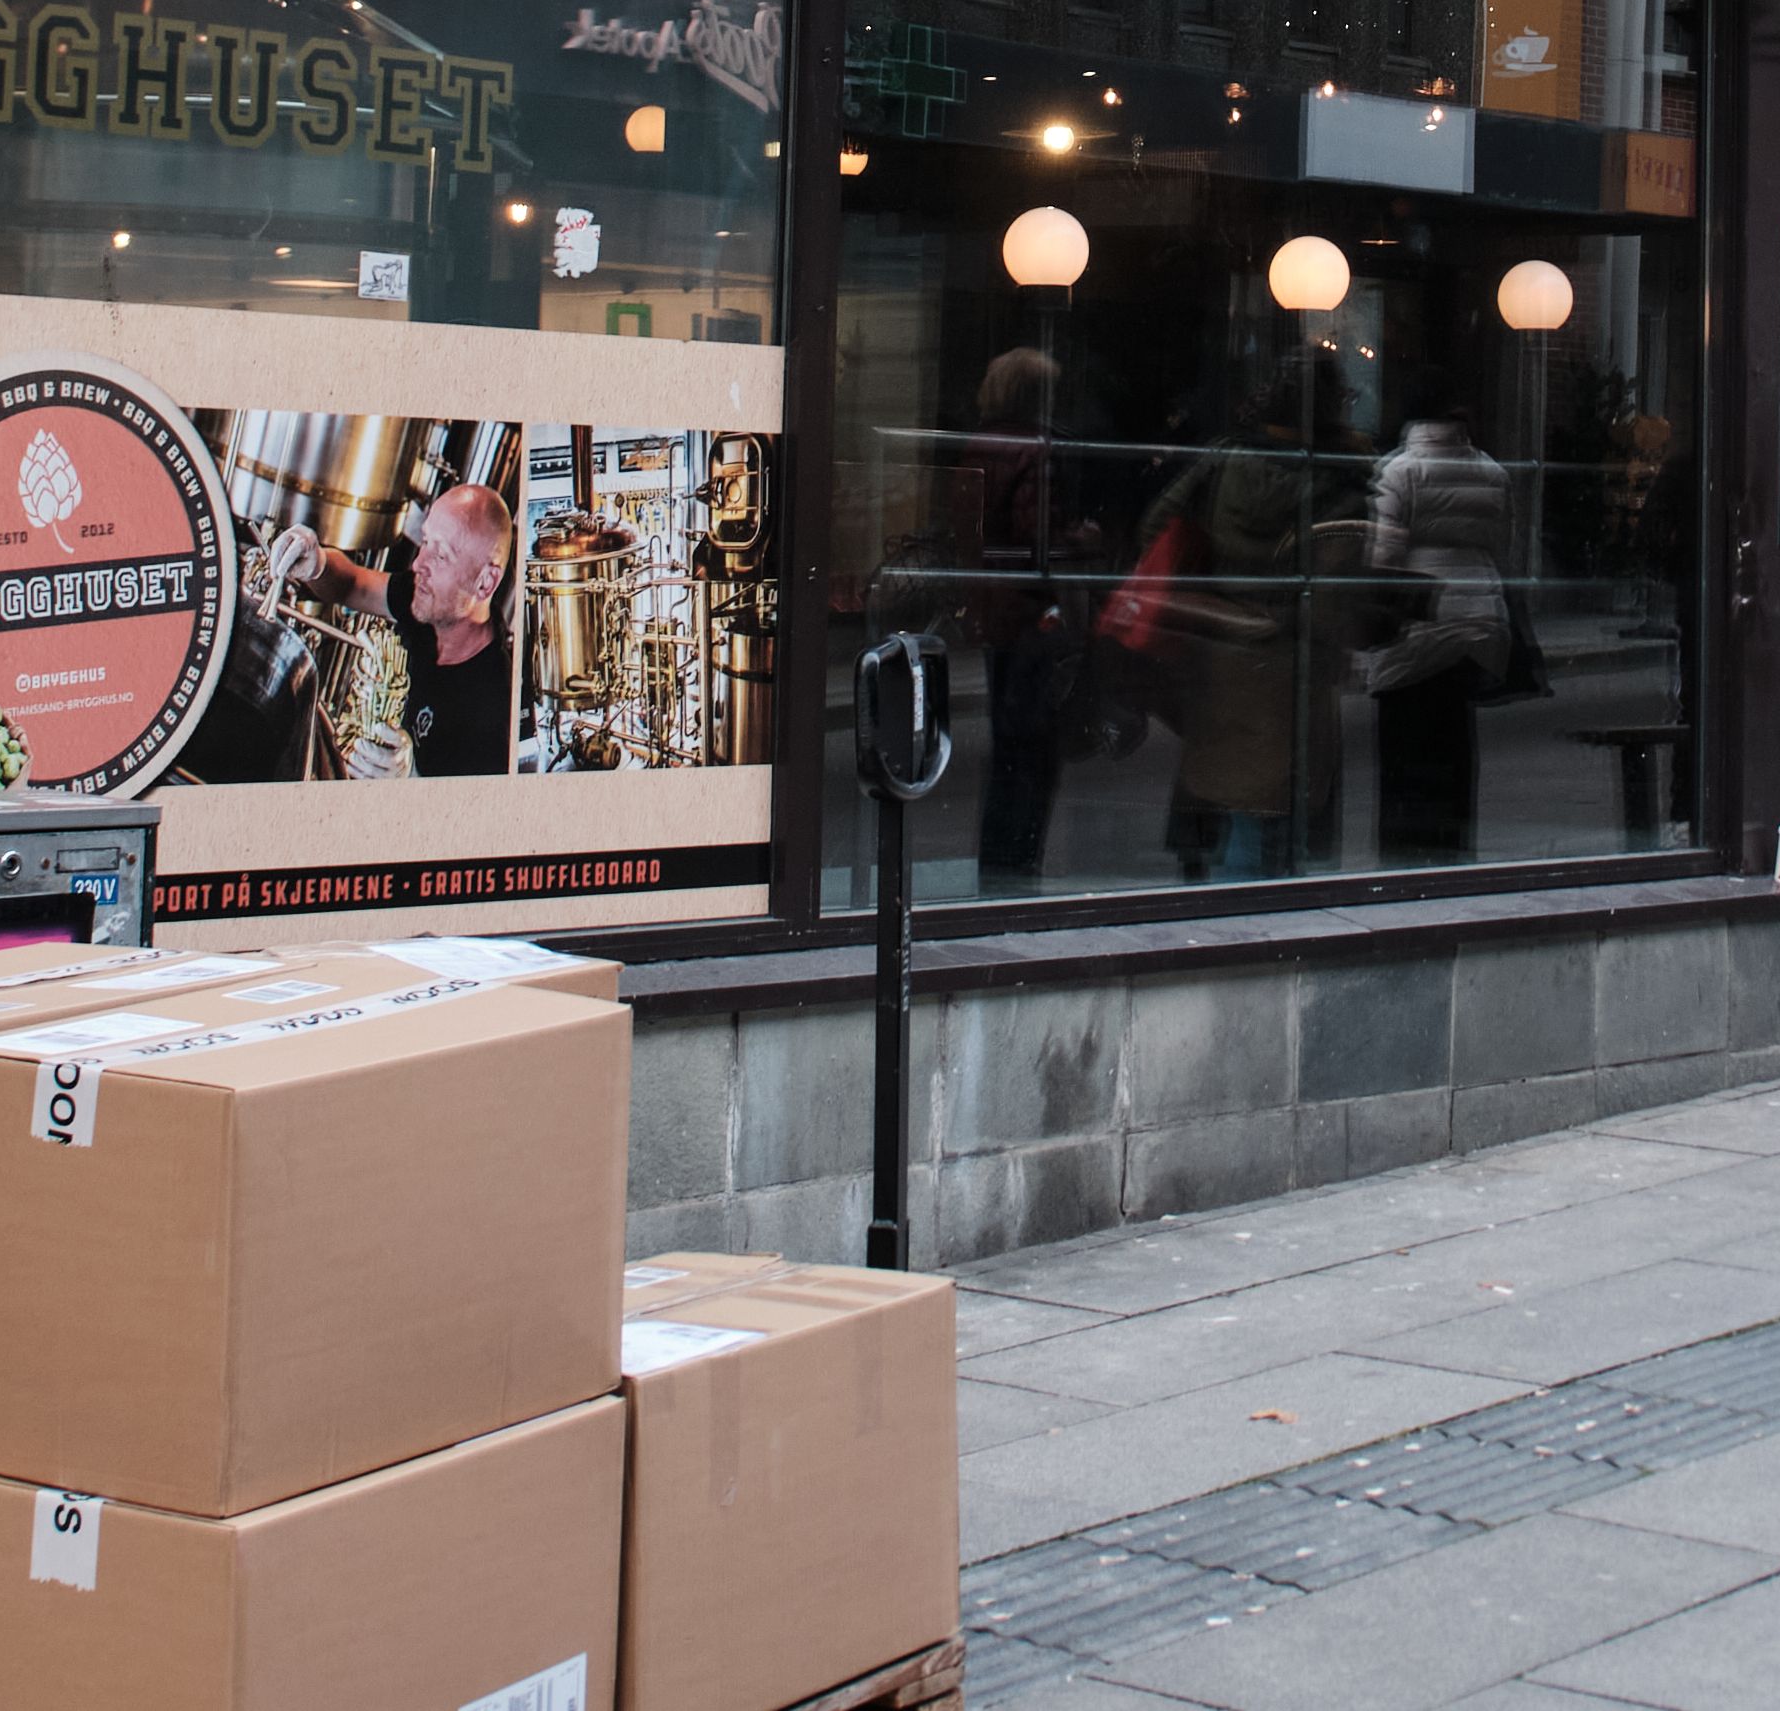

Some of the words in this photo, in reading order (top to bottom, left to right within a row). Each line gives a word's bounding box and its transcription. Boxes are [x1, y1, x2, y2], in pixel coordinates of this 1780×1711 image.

[2, 384, 39, 409] BBQ
[59, 381, 110, 406] BREW
[122, 401, 155, 436] BBQ
[166, 443, 202, 499] BREW
[80, 522, 116, 539] 2012
[197, 516, 216, 560] BBQ
[197, 586, 217, 648] BREW
[173, 664, 202, 709] BBQ
[121, 724, 166, 772] BREW
[153, 883, 212, 913] PORT
[221, 873, 251, 909] PÅ
[261, 874, 394, 908] SKJERMENE
[420, 867, 497, 897] GRATIS
[504, 859, 662, 894] SHUFFLEBOARD
